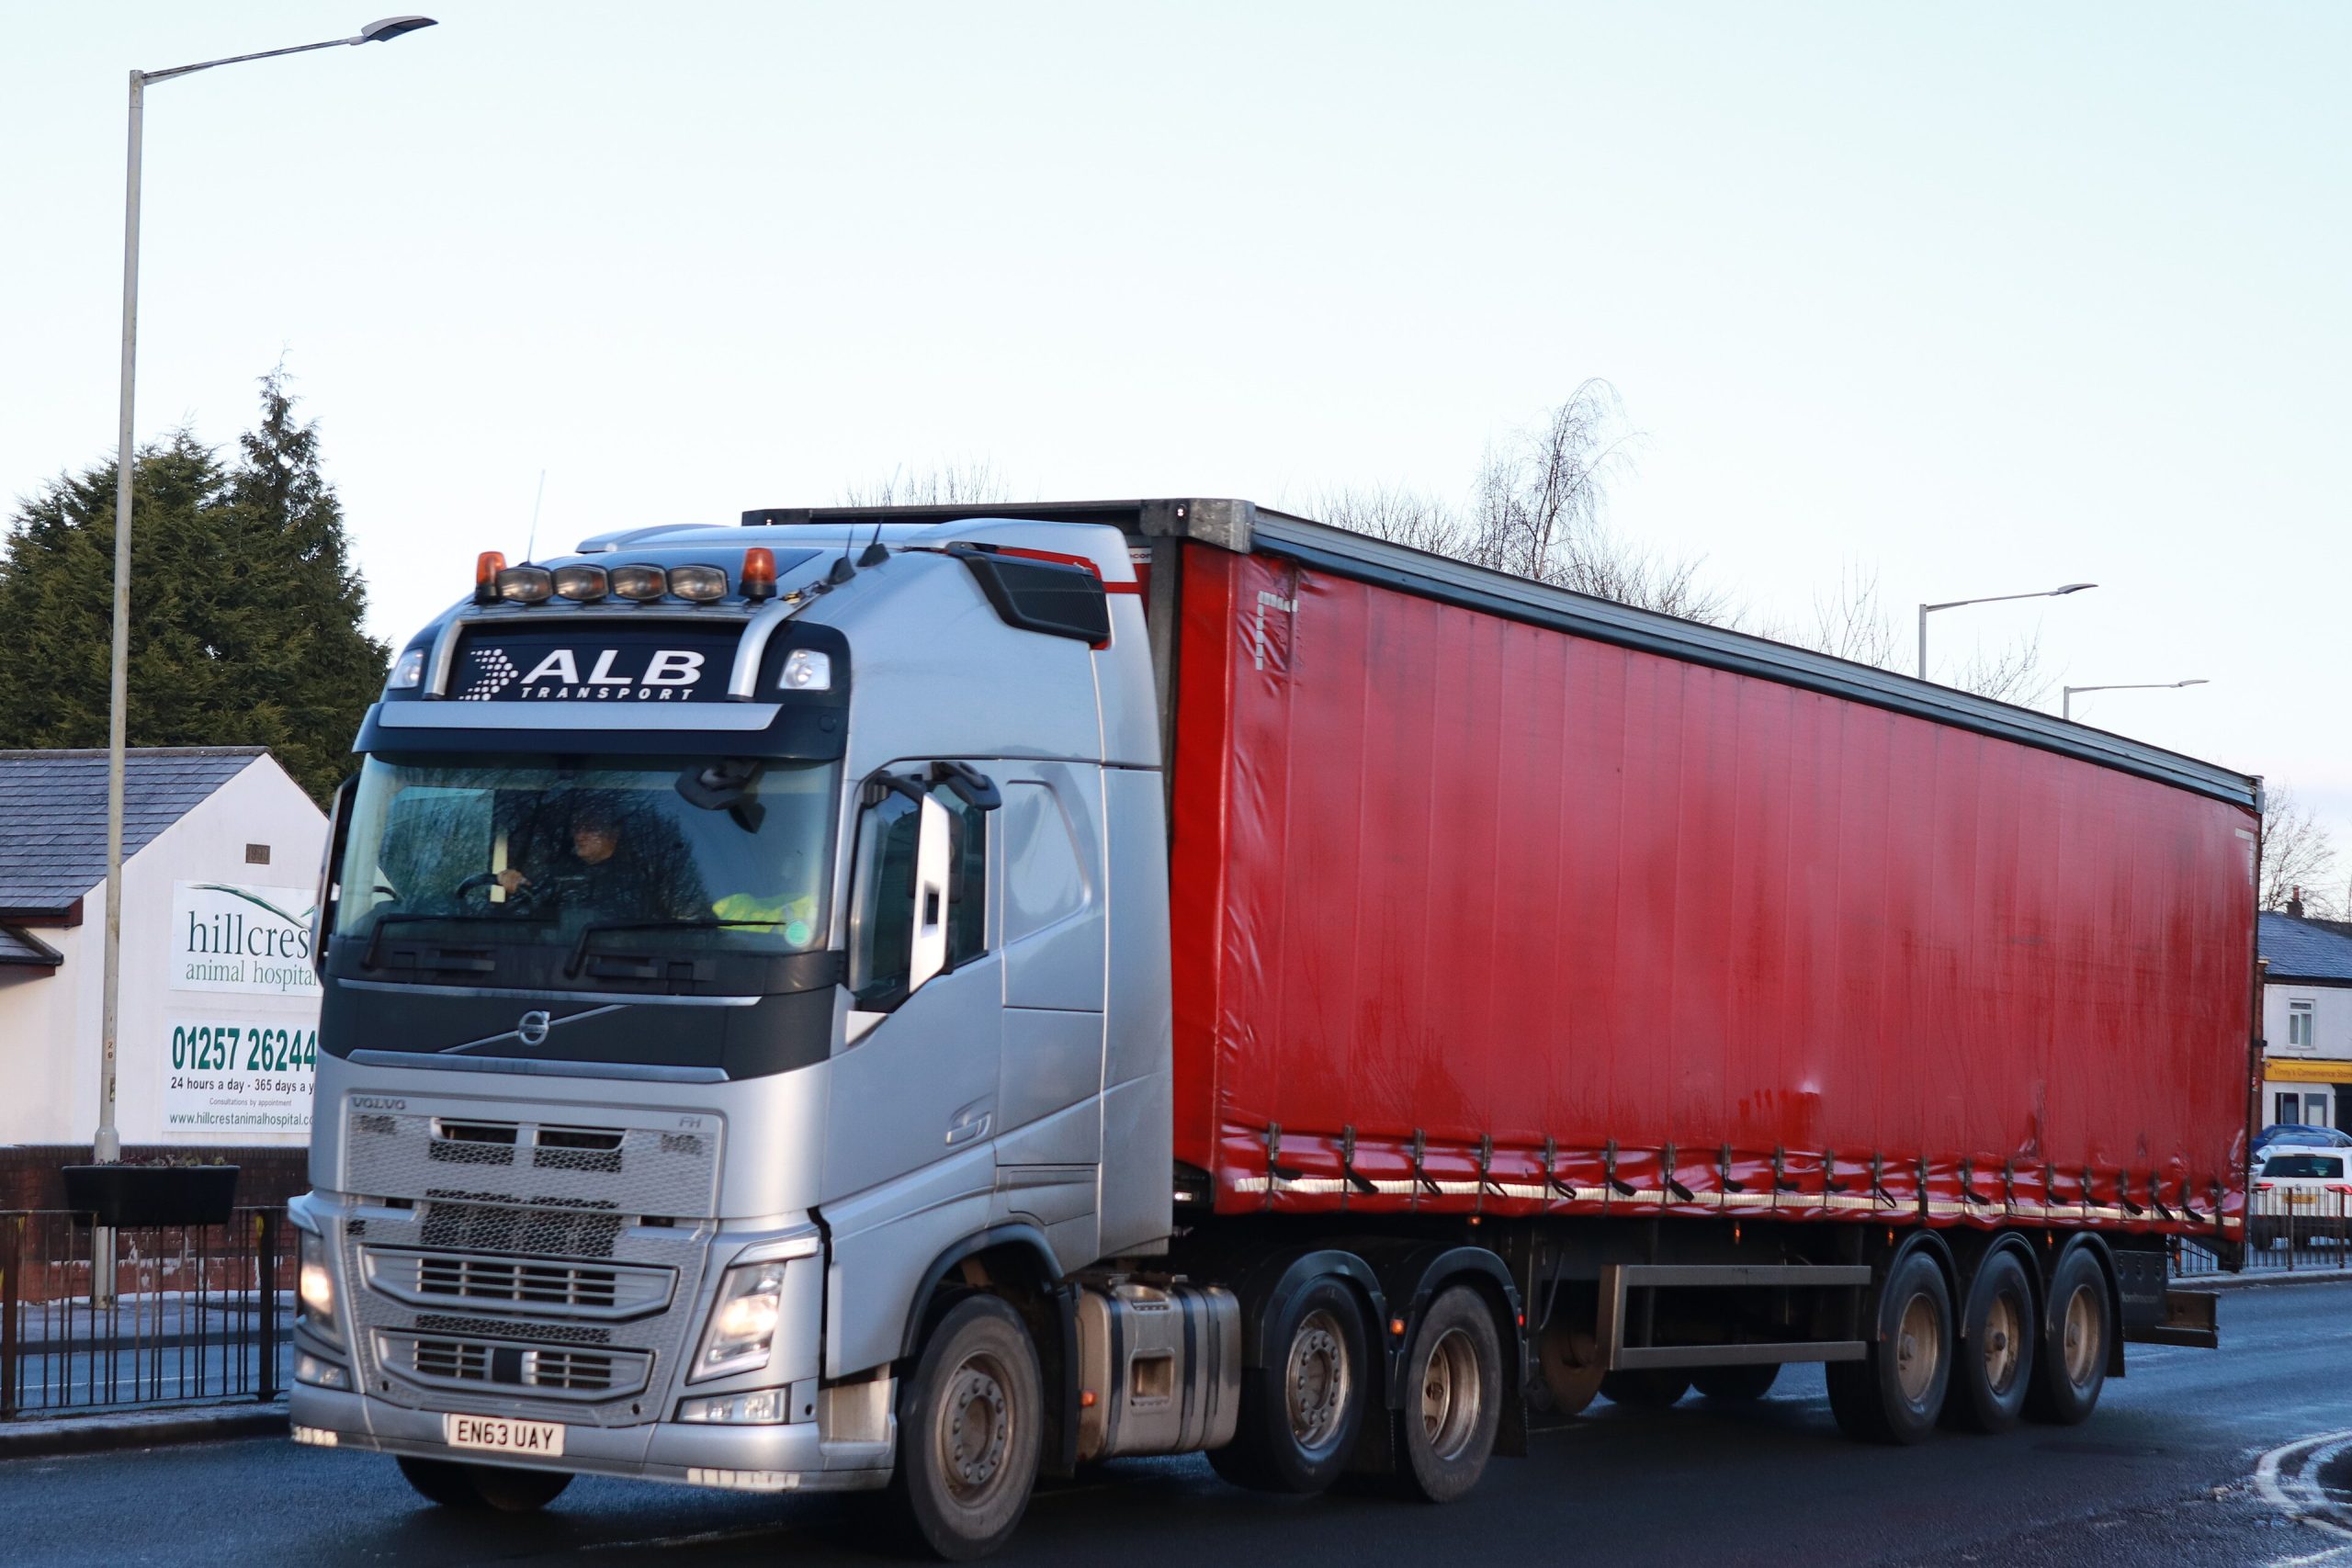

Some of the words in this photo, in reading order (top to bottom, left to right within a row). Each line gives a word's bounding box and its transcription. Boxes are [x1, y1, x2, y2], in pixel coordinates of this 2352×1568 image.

[519, 649, 706, 685] ALB
[521, 686, 694, 700] TRANSPORT
[187, 910, 311, 959] hillcres
[186, 959, 244, 982] animal
[253, 960, 318, 991] hospital
[172, 1025, 241, 1070] 01257
[246, 1027, 317, 1072] 26244
[171, 1077, 184, 1089] 24
[187, 1077, 214, 1090] hours
[218, 1080, 224, 1090] a
[227, 1078, 244, 1094] day
[254, 1078, 272, 1091] 365
[275, 1079, 297, 1095] days
[300, 1082, 306, 1092] a
[309, 1082, 314, 1095] y
[209, 1097, 248, 1106] Consultations
[249, 1098, 257, 1108] by
[258, 1099, 292, 1108] appointment
[351, 1097, 406, 1110] VOLVO
[458, 1419, 508, 1445] EN63
[514, 1425, 554, 1450] UAY
